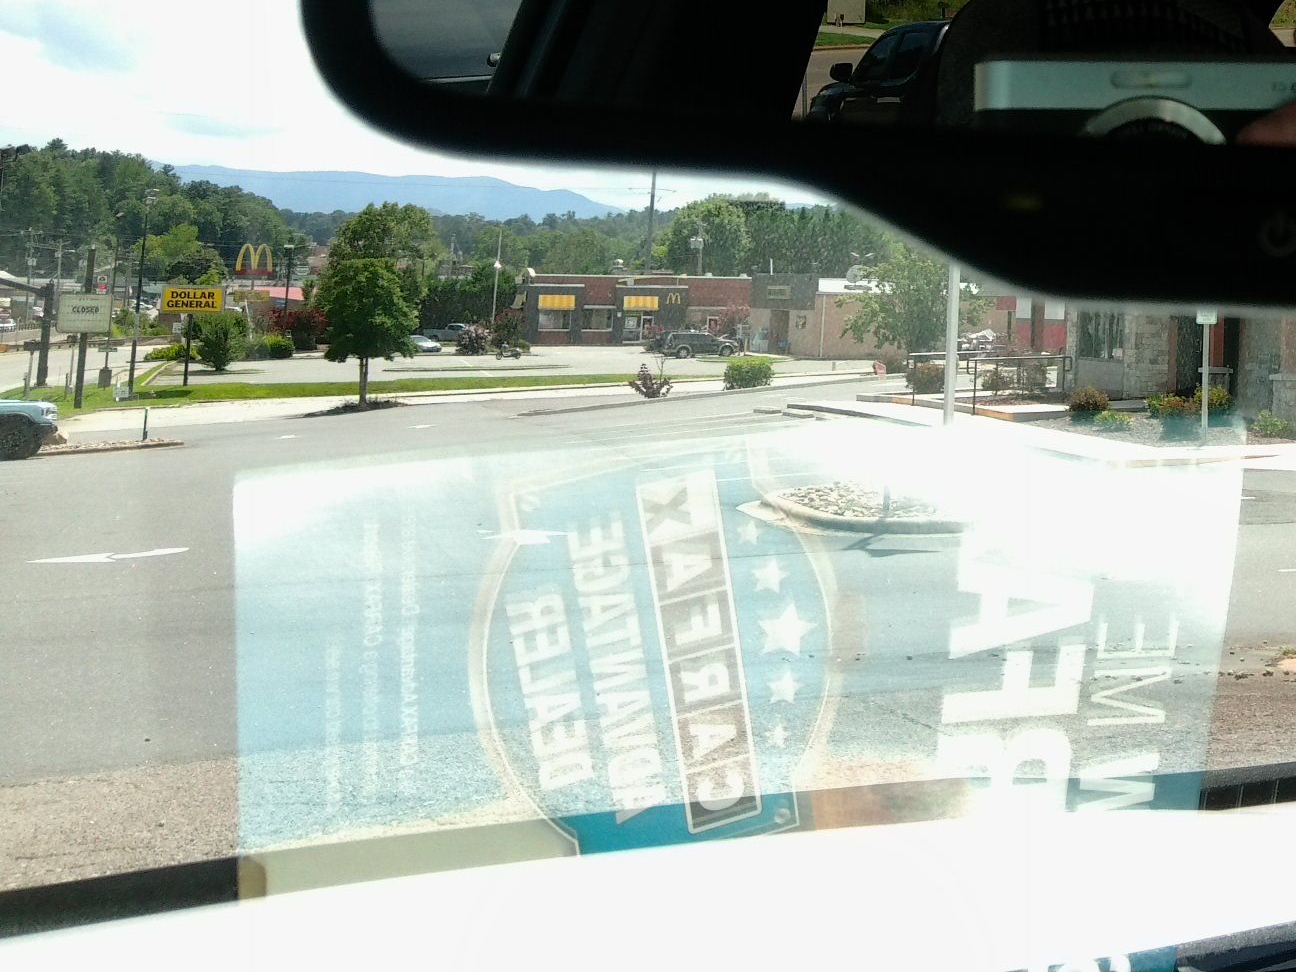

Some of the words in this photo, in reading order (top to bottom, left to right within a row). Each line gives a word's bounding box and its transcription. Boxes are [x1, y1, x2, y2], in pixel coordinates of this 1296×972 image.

[171, 290, 215, 299] DOLLAR
[166, 300, 217, 309] GENERAL
[71, 306, 100, 314] CLOSED
